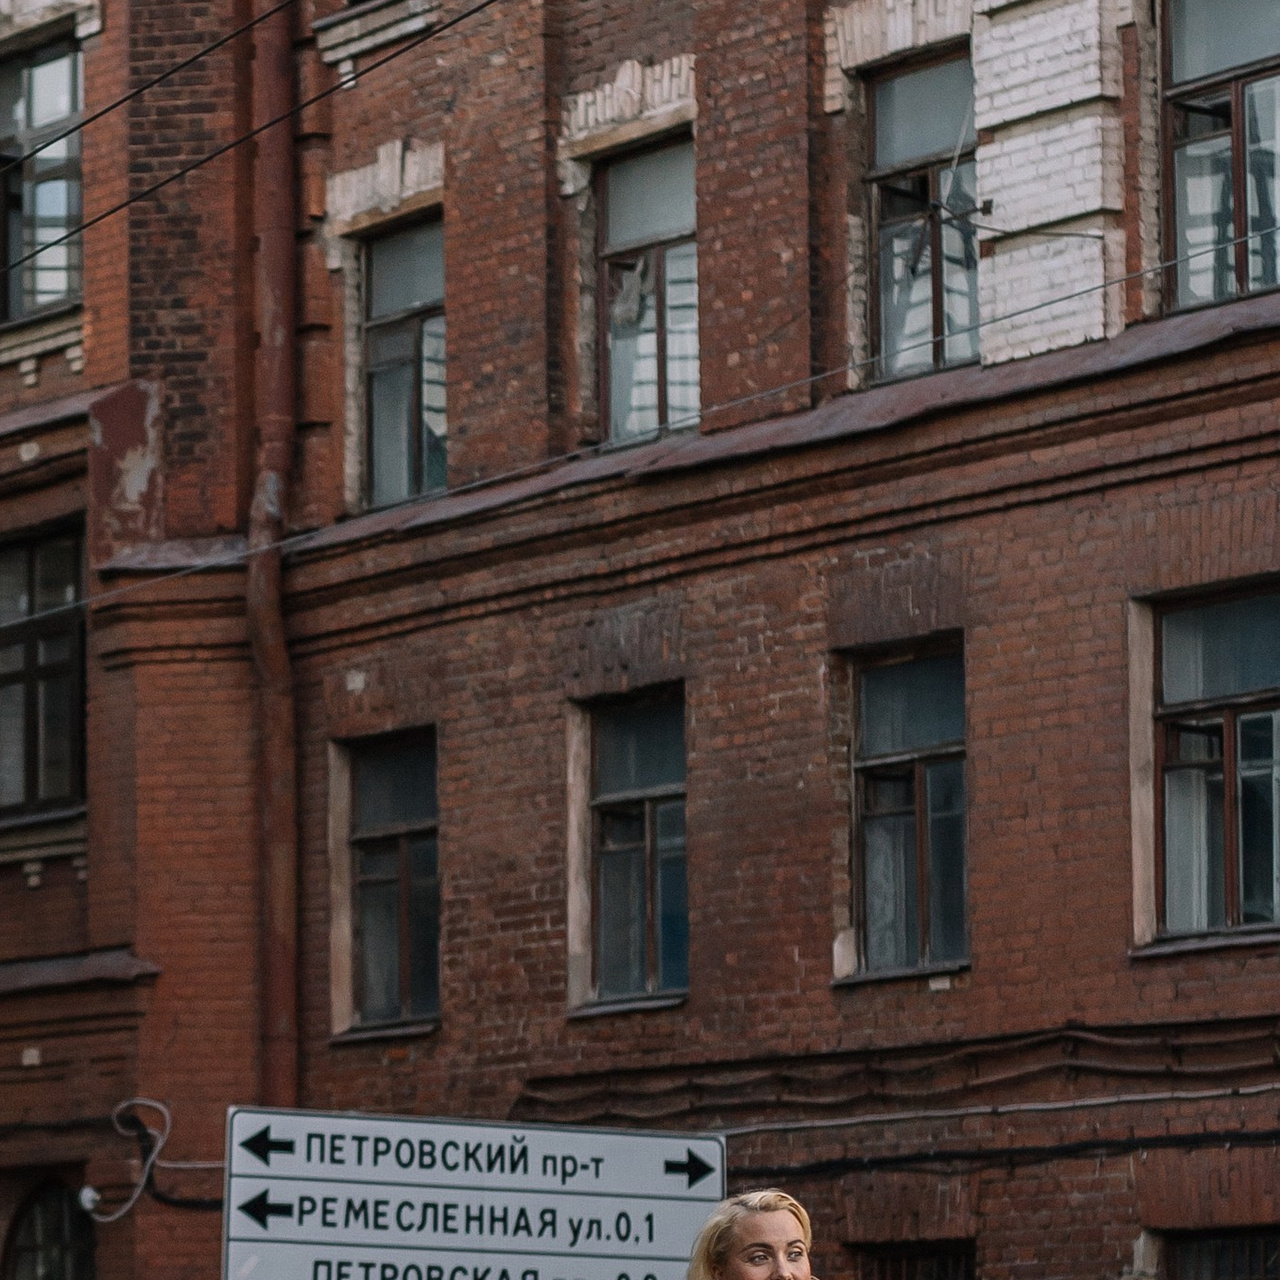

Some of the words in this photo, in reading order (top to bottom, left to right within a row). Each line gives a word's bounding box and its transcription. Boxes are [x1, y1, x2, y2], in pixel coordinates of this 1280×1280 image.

[305, 1132, 530, 1176] ПЕТРОВСКИЙ
[540, 1153, 606, 1186] пр-т
[296, 1194, 559, 1240] РЕМЕСЛЕННАЯ
